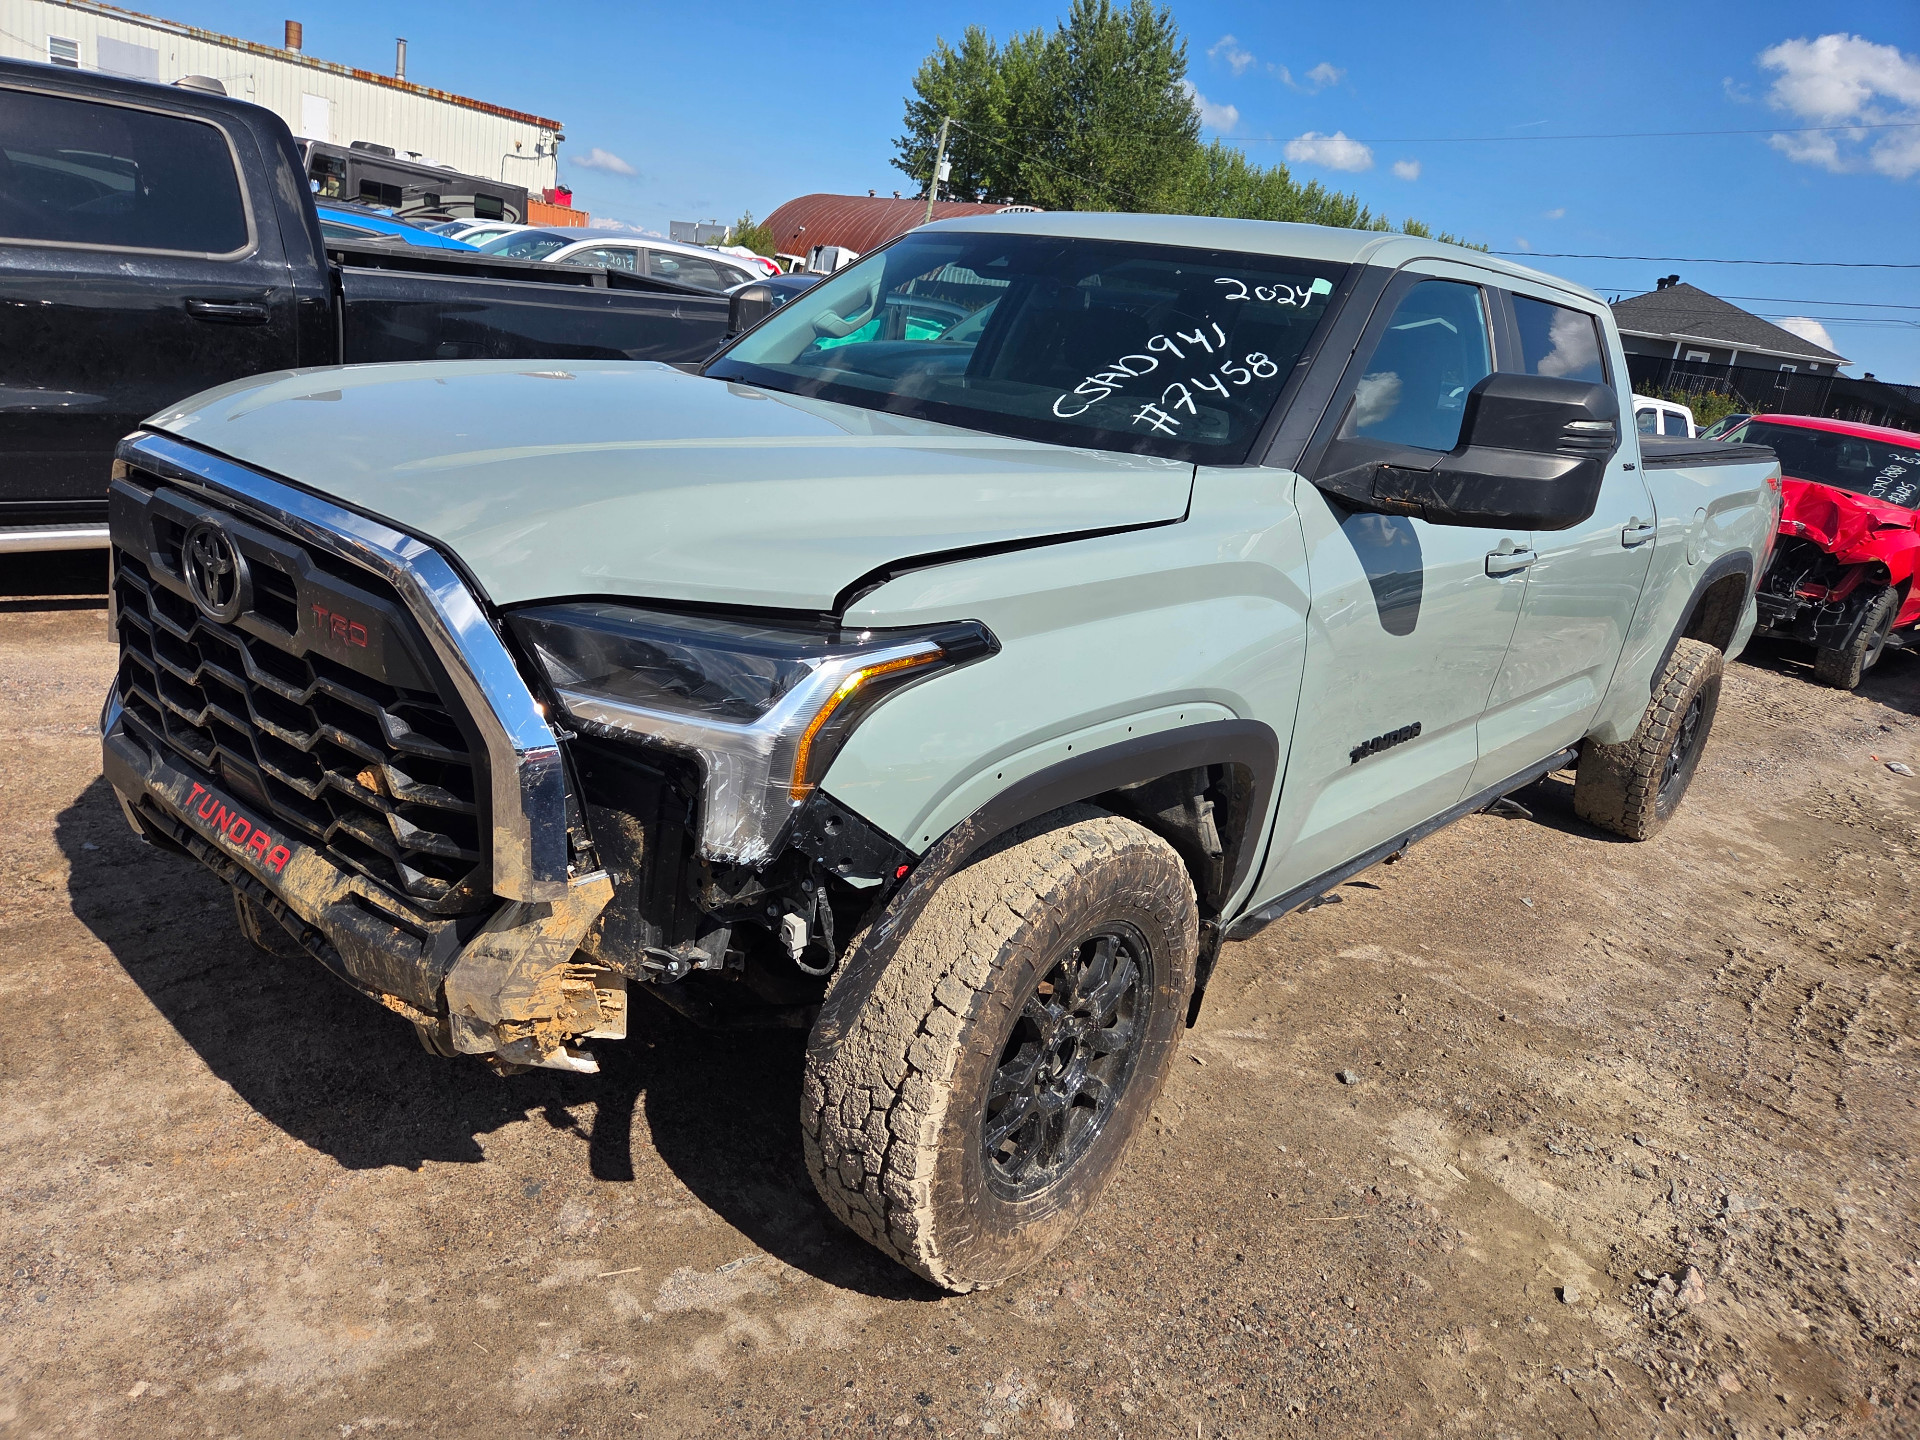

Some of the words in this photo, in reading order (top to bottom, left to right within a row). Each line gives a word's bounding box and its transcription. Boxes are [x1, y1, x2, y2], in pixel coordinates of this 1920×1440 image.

[1214, 277, 1313, 308] 2024
[1131, 352, 1278, 436] #7458
[311, 603, 368, 648] TRD
[1349, 721, 1422, 767] TUNDRA
[183, 781, 291, 874] TUNDRA
